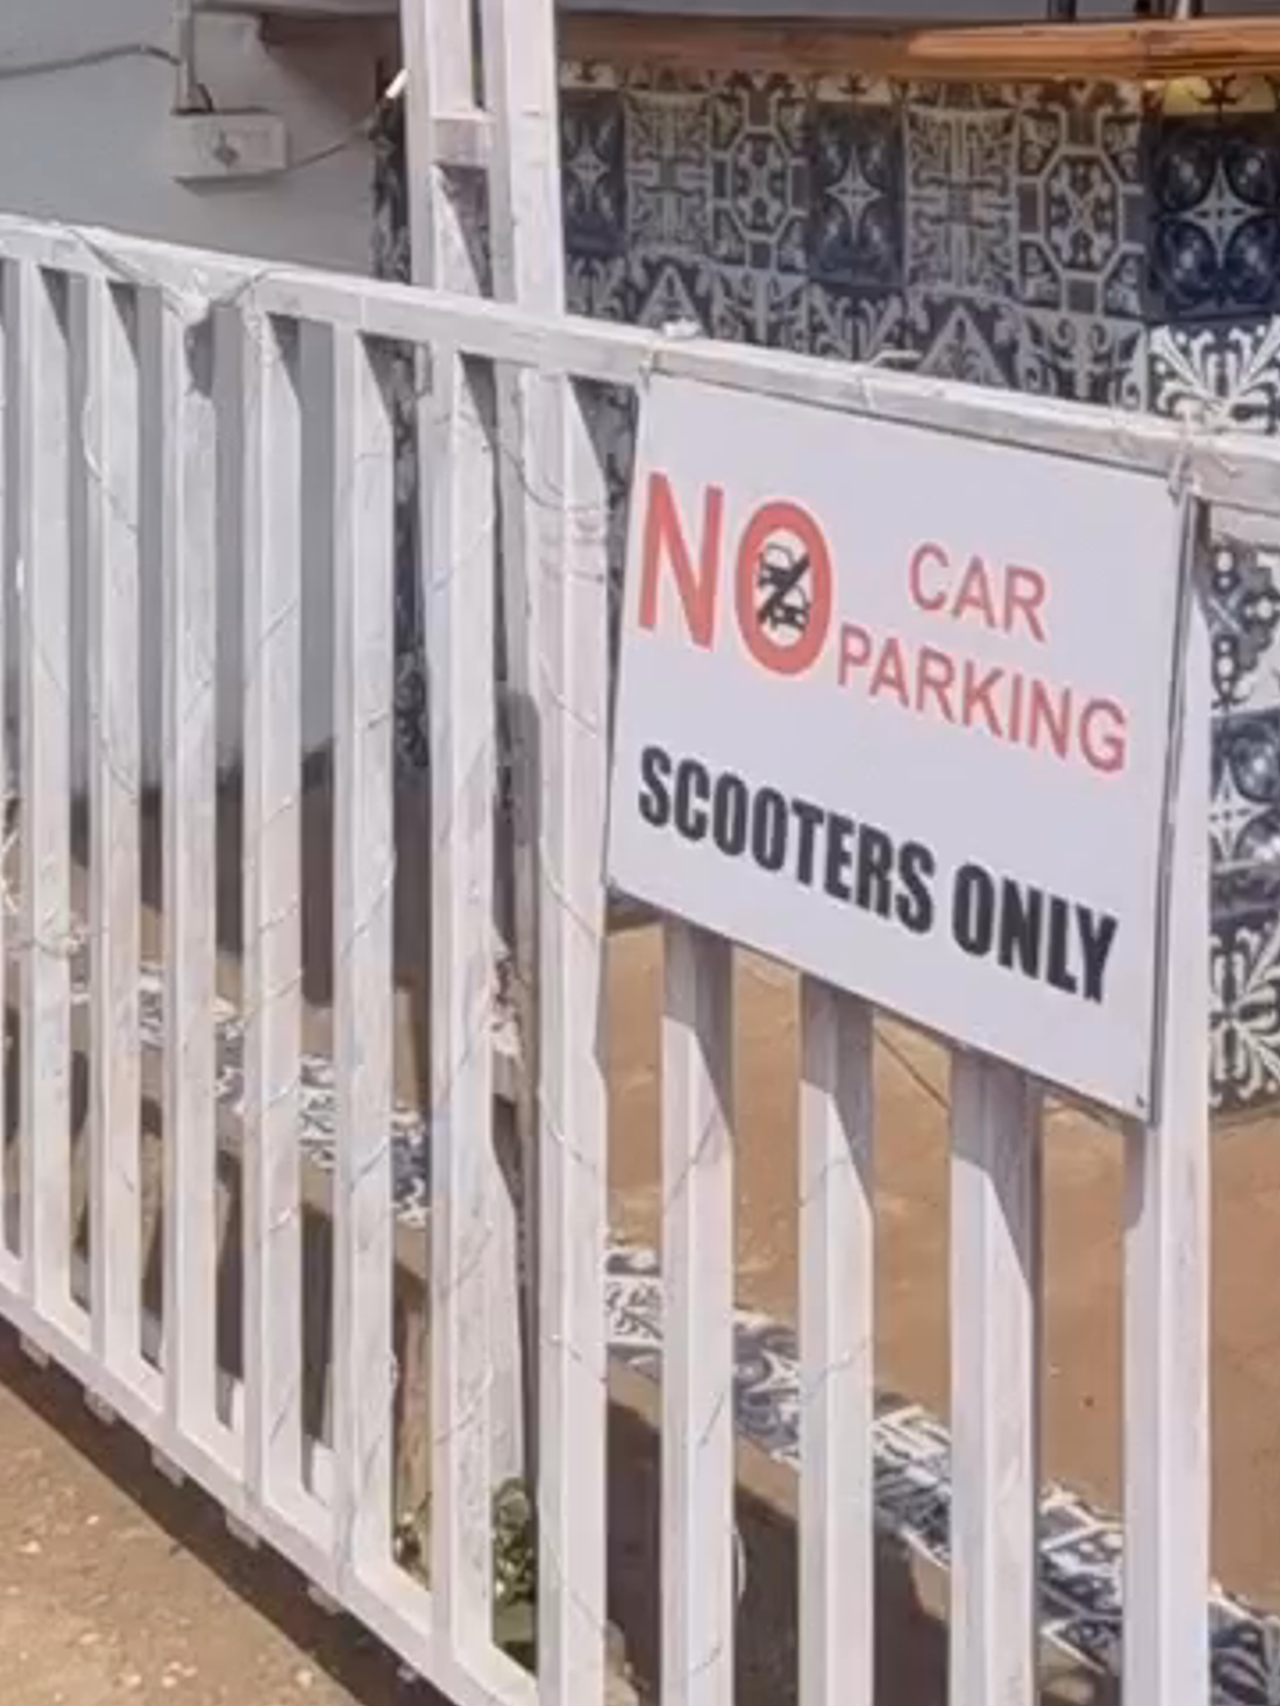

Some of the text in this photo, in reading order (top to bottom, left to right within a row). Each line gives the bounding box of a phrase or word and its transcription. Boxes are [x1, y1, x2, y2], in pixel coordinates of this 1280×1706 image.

[637, 471, 832, 676] NO
[908, 543, 1048, 643] CAR
[837, 623, 1128, 773] PARKING
[637, 745, 1120, 1006] SCOOTERS ONLY
